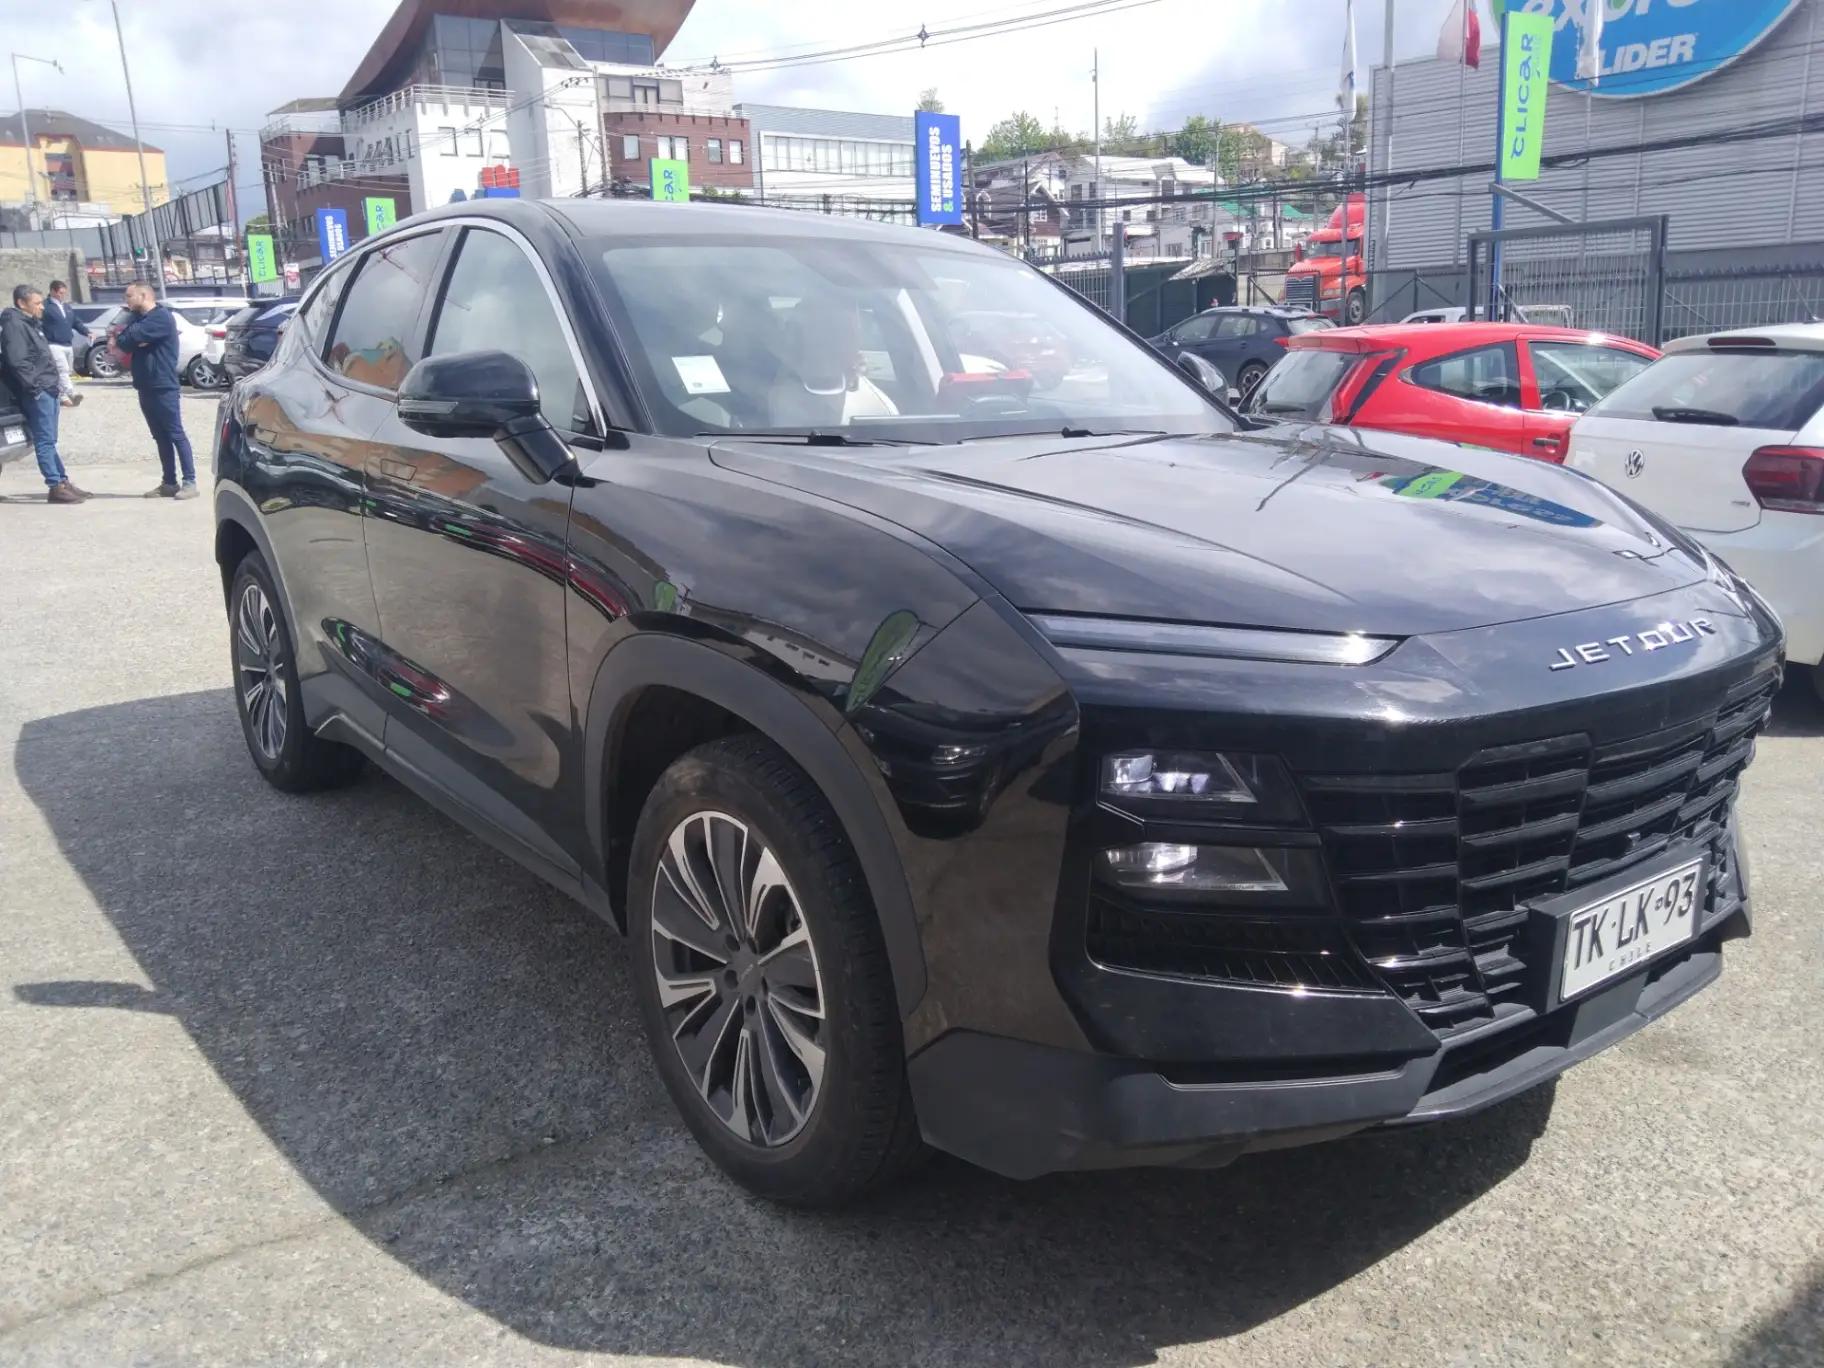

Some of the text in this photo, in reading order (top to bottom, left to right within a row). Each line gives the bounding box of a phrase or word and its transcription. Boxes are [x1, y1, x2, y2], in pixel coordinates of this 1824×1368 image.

[1600, 33, 1697, 76] LIDER
[928, 126, 942, 213] SEMINUEVOS
[941, 143, 953, 198] USADOS
[1549, 617, 1716, 671] JETOUR
